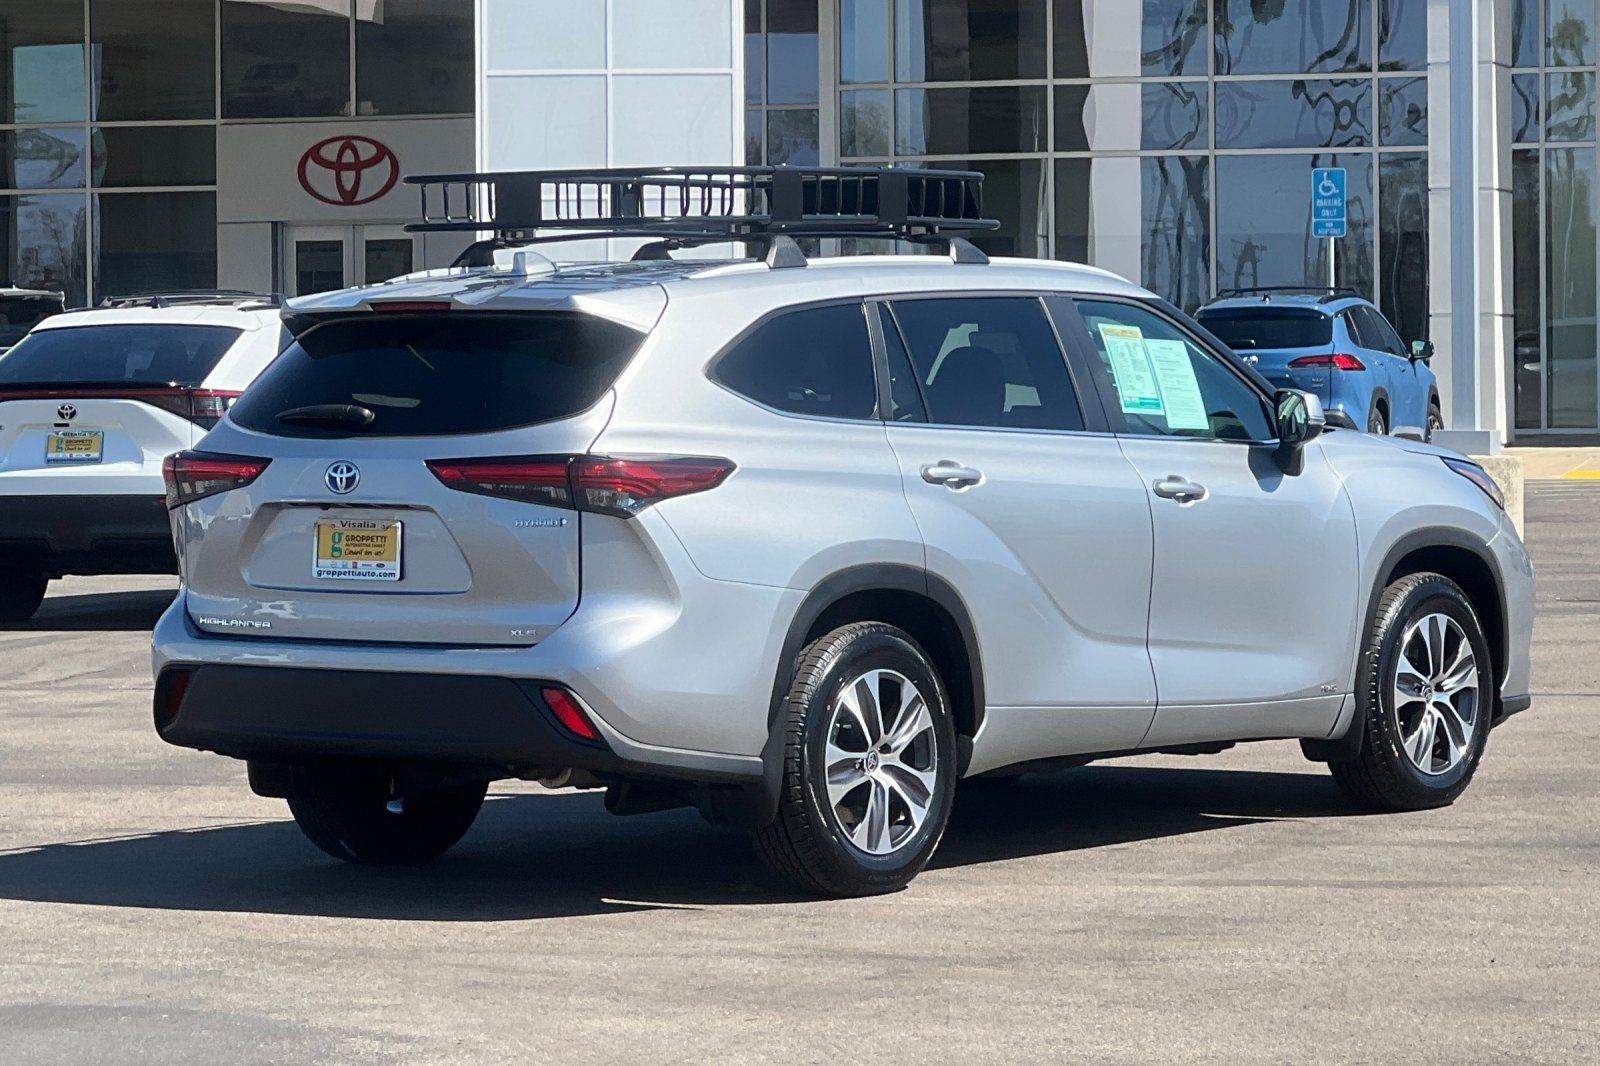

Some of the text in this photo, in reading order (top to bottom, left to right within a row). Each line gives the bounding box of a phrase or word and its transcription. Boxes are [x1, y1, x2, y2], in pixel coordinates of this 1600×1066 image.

[1316, 198, 1342, 207] PARKING
[1321, 208, 1337, 217] ONLY
[514, 519, 559, 528] HYBRID
[345, 535, 386, 543] GROPPETTI
[317, 569, 396, 578] groppettiauto.com
[199, 616, 271, 628] HIGHLANDER
[510, 629, 537, 637] XLE
